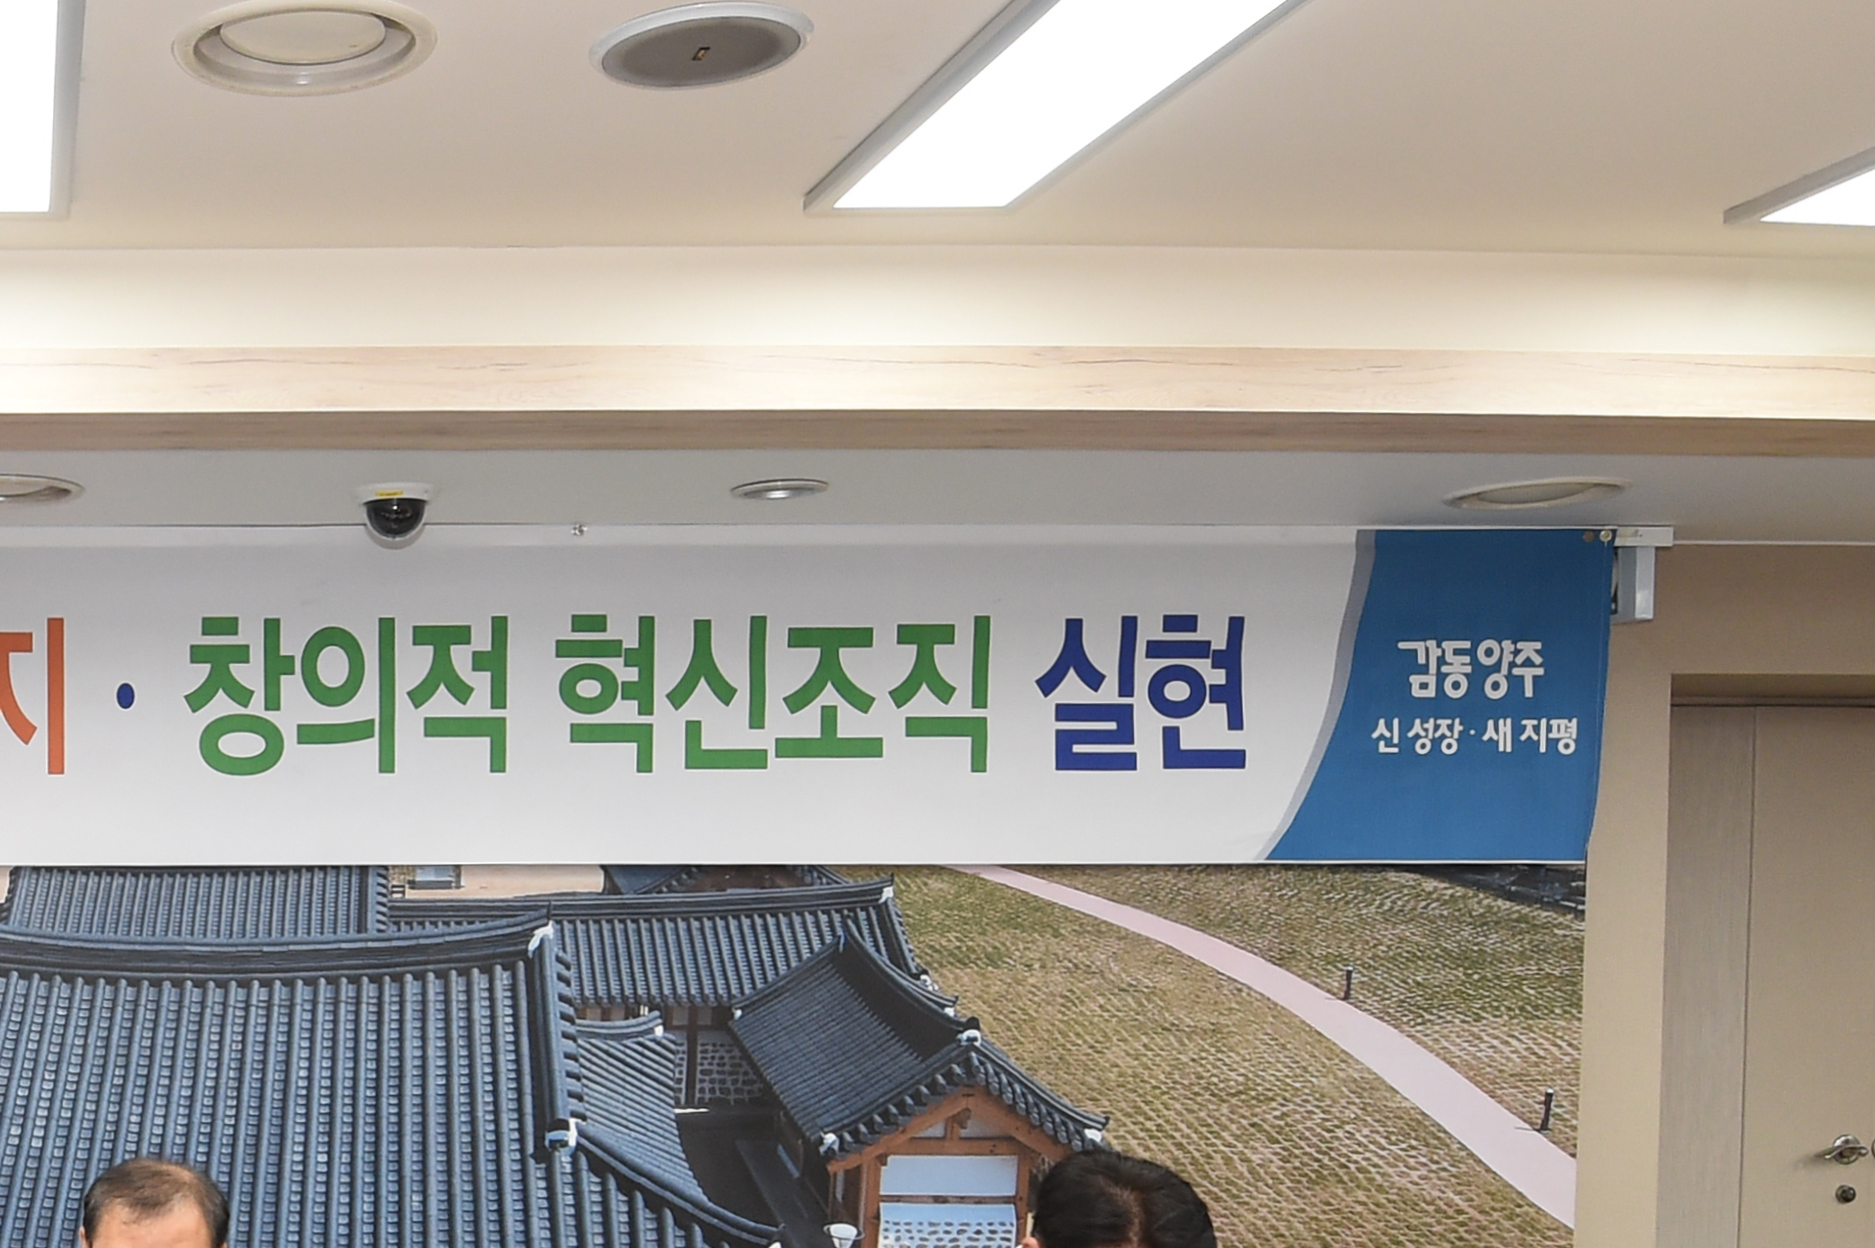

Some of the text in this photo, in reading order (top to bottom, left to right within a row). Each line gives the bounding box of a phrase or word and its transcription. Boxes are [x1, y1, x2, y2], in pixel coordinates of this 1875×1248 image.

[184, 615, 508, 776] 창의적
[555, 615, 991, 773] 혁신조직
[1036, 615, 1247, 771] 실현
[1397, 638, 1545, 700] 감동양주
